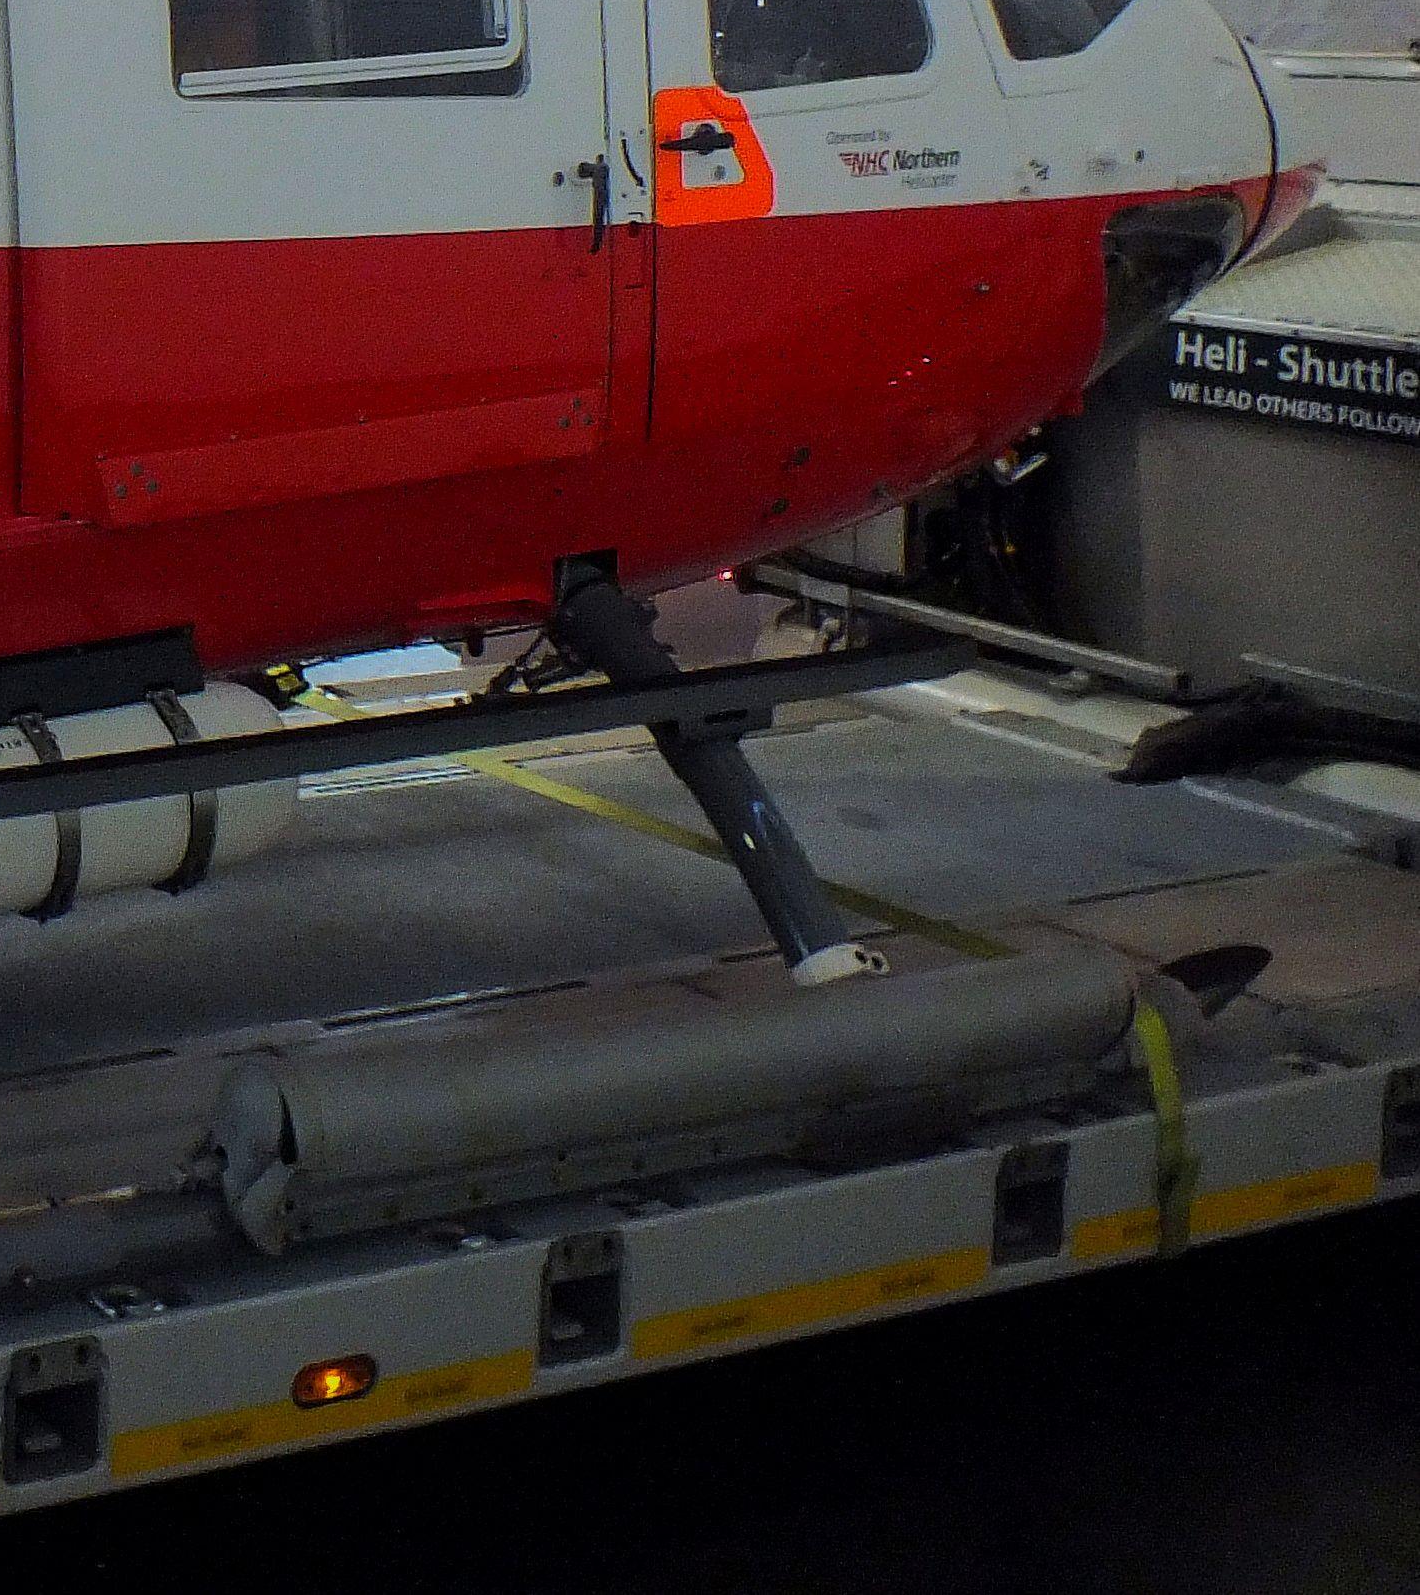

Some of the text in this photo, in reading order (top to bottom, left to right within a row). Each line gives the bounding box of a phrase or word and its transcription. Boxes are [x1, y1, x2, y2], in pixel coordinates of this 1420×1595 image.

[849, 147, 961, 174] NHC Northern
[1175, 330, 1247, 374] Heli
[1276, 343, 1420, 399] Shuttle
[1169, 380, 1420, 436] WE LEAD OTHERS FOLLOW
